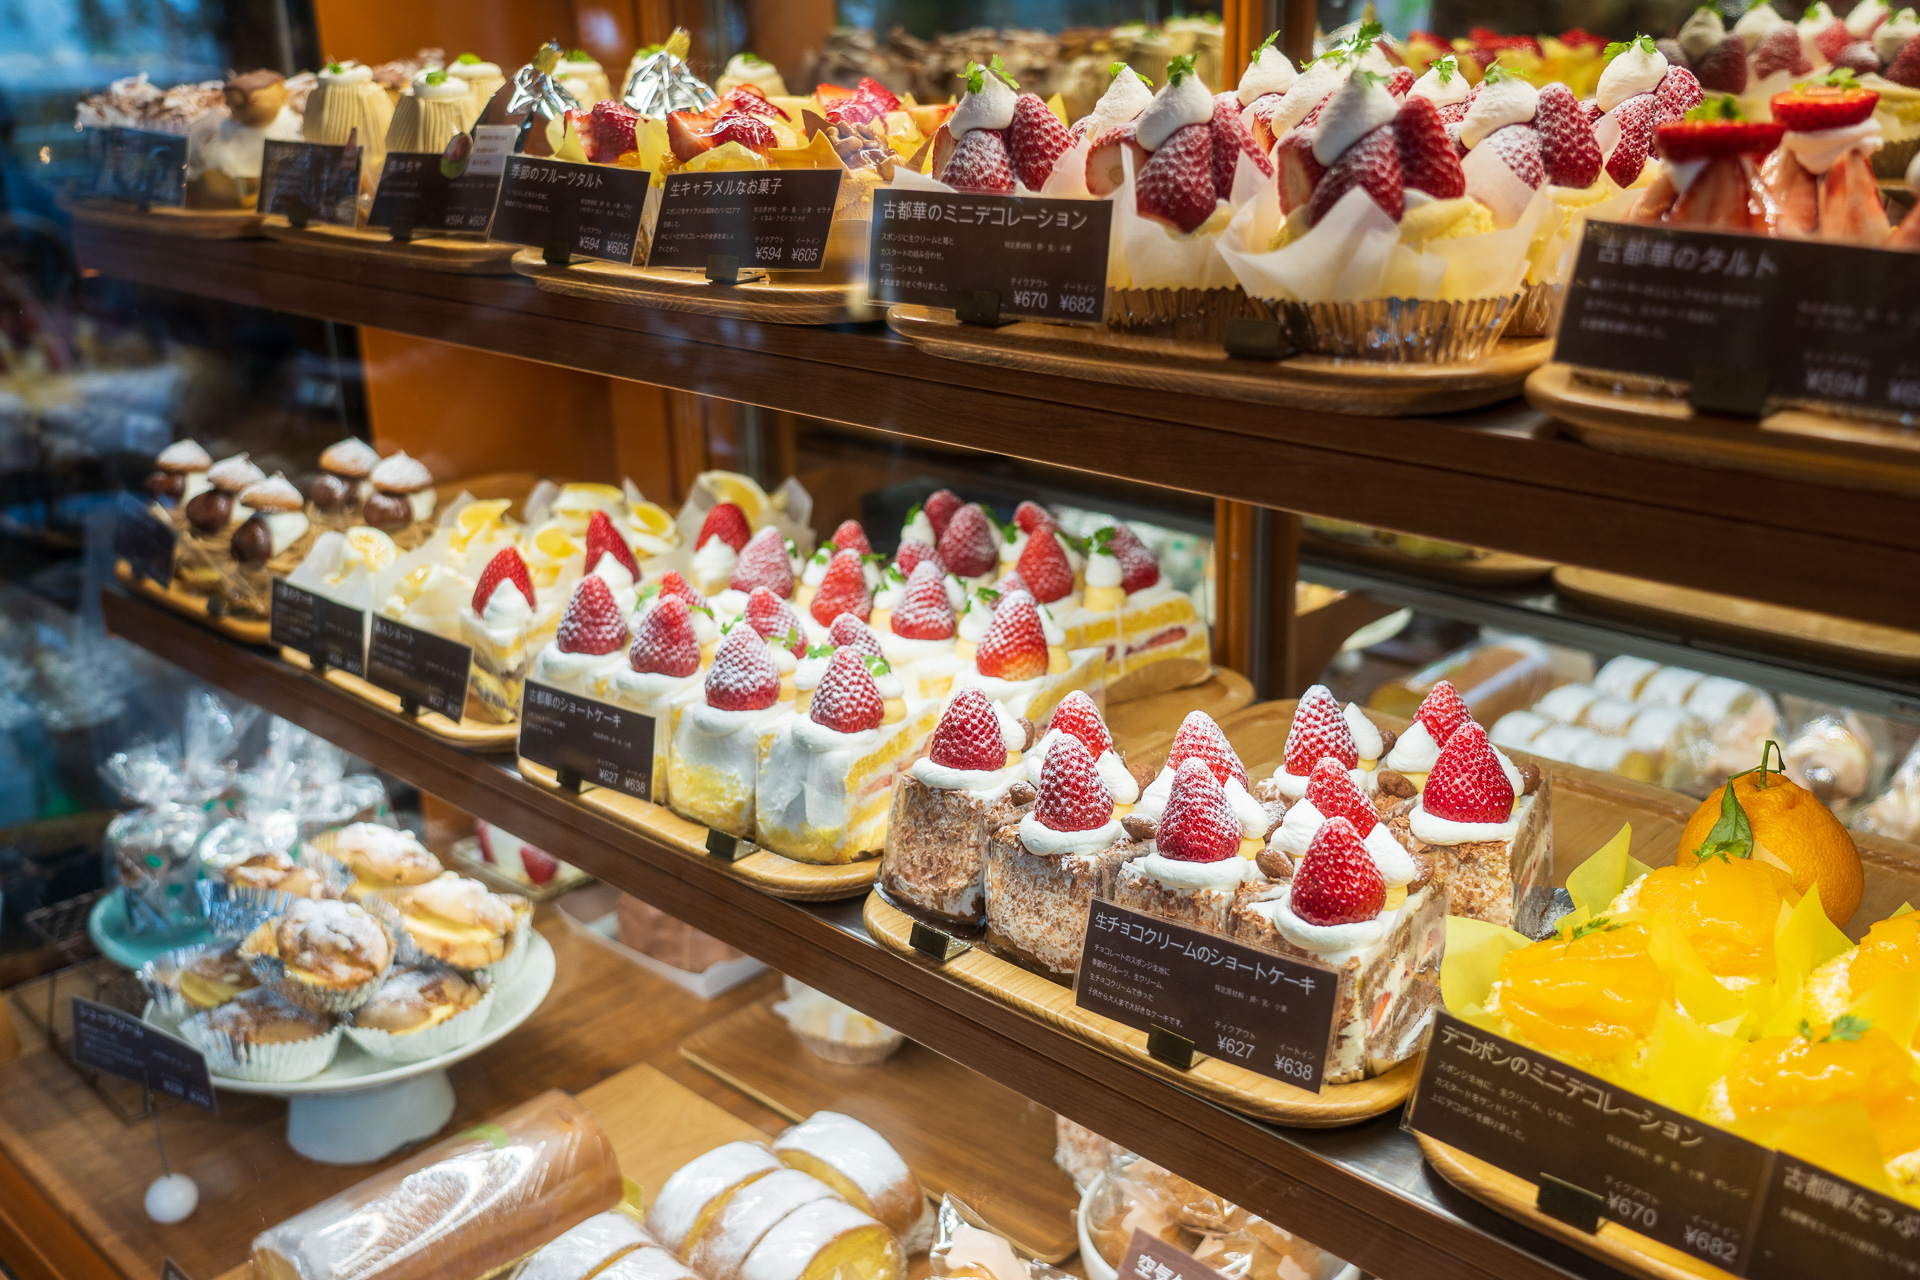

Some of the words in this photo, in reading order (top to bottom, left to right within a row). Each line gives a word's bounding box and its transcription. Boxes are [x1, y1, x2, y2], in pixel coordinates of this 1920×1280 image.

[511, 164, 602, 189] 季節のフルーツタルト
[669, 178, 782, 197] 生キャラメルなお菓子
[883, 200, 1088, 230] 古都華のミニデコレーション
[579, 236, 600, 250] ¥594
[607, 240, 629, 255] ¥605
[755, 246, 782, 260] ¥594
[791, 248, 818, 262] ¥605
[1597, 238, 1778, 279] 古都華のタルト
[879, 263, 924, 275] デコレーションを
[1010, 277, 1049, 288] テイクアウト
[1063, 283, 1097, 293] イートイン
[1014, 290, 1048, 309] ¥670
[1060, 295, 1095, 314] ¥682
[529, 688, 621, 728] 古都華のショートケーキ
[599, 768, 619, 785] ¥627
[625, 777, 646, 794] ¥638
[1094, 911, 1316, 995] 生チョコクリームのショートケーキ
[1094, 943, 1171, 976] チョコレートのスポンジ生地に
[1089, 972, 1154, 1002] 生チョコクリームで作った
[1091, 957, 1165, 990] 季節のフルーツ、生クリーム、
[1087, 985, 1184, 1029] 子供から大人まで大好きなケーキです。
[1214, 1020, 1257, 1040] テイクアウト
[1279, 1043, 1315, 1061] イートイン
[1217, 1034, 1255, 1059] ¥627
[1274, 1053, 1313, 1081] ¥638
[1440, 1023, 1705, 1147] デコポンのミニデコレーション
[1604, 1175, 1660, 1205] テイクアウト
[1691, 1213, 1743, 1240] イートイン
[1607, 1191, 1658, 1229] ¥670
[1683, 1224, 1739, 1264] ¥682
[1134, 1253, 1183, 1280] 空気
